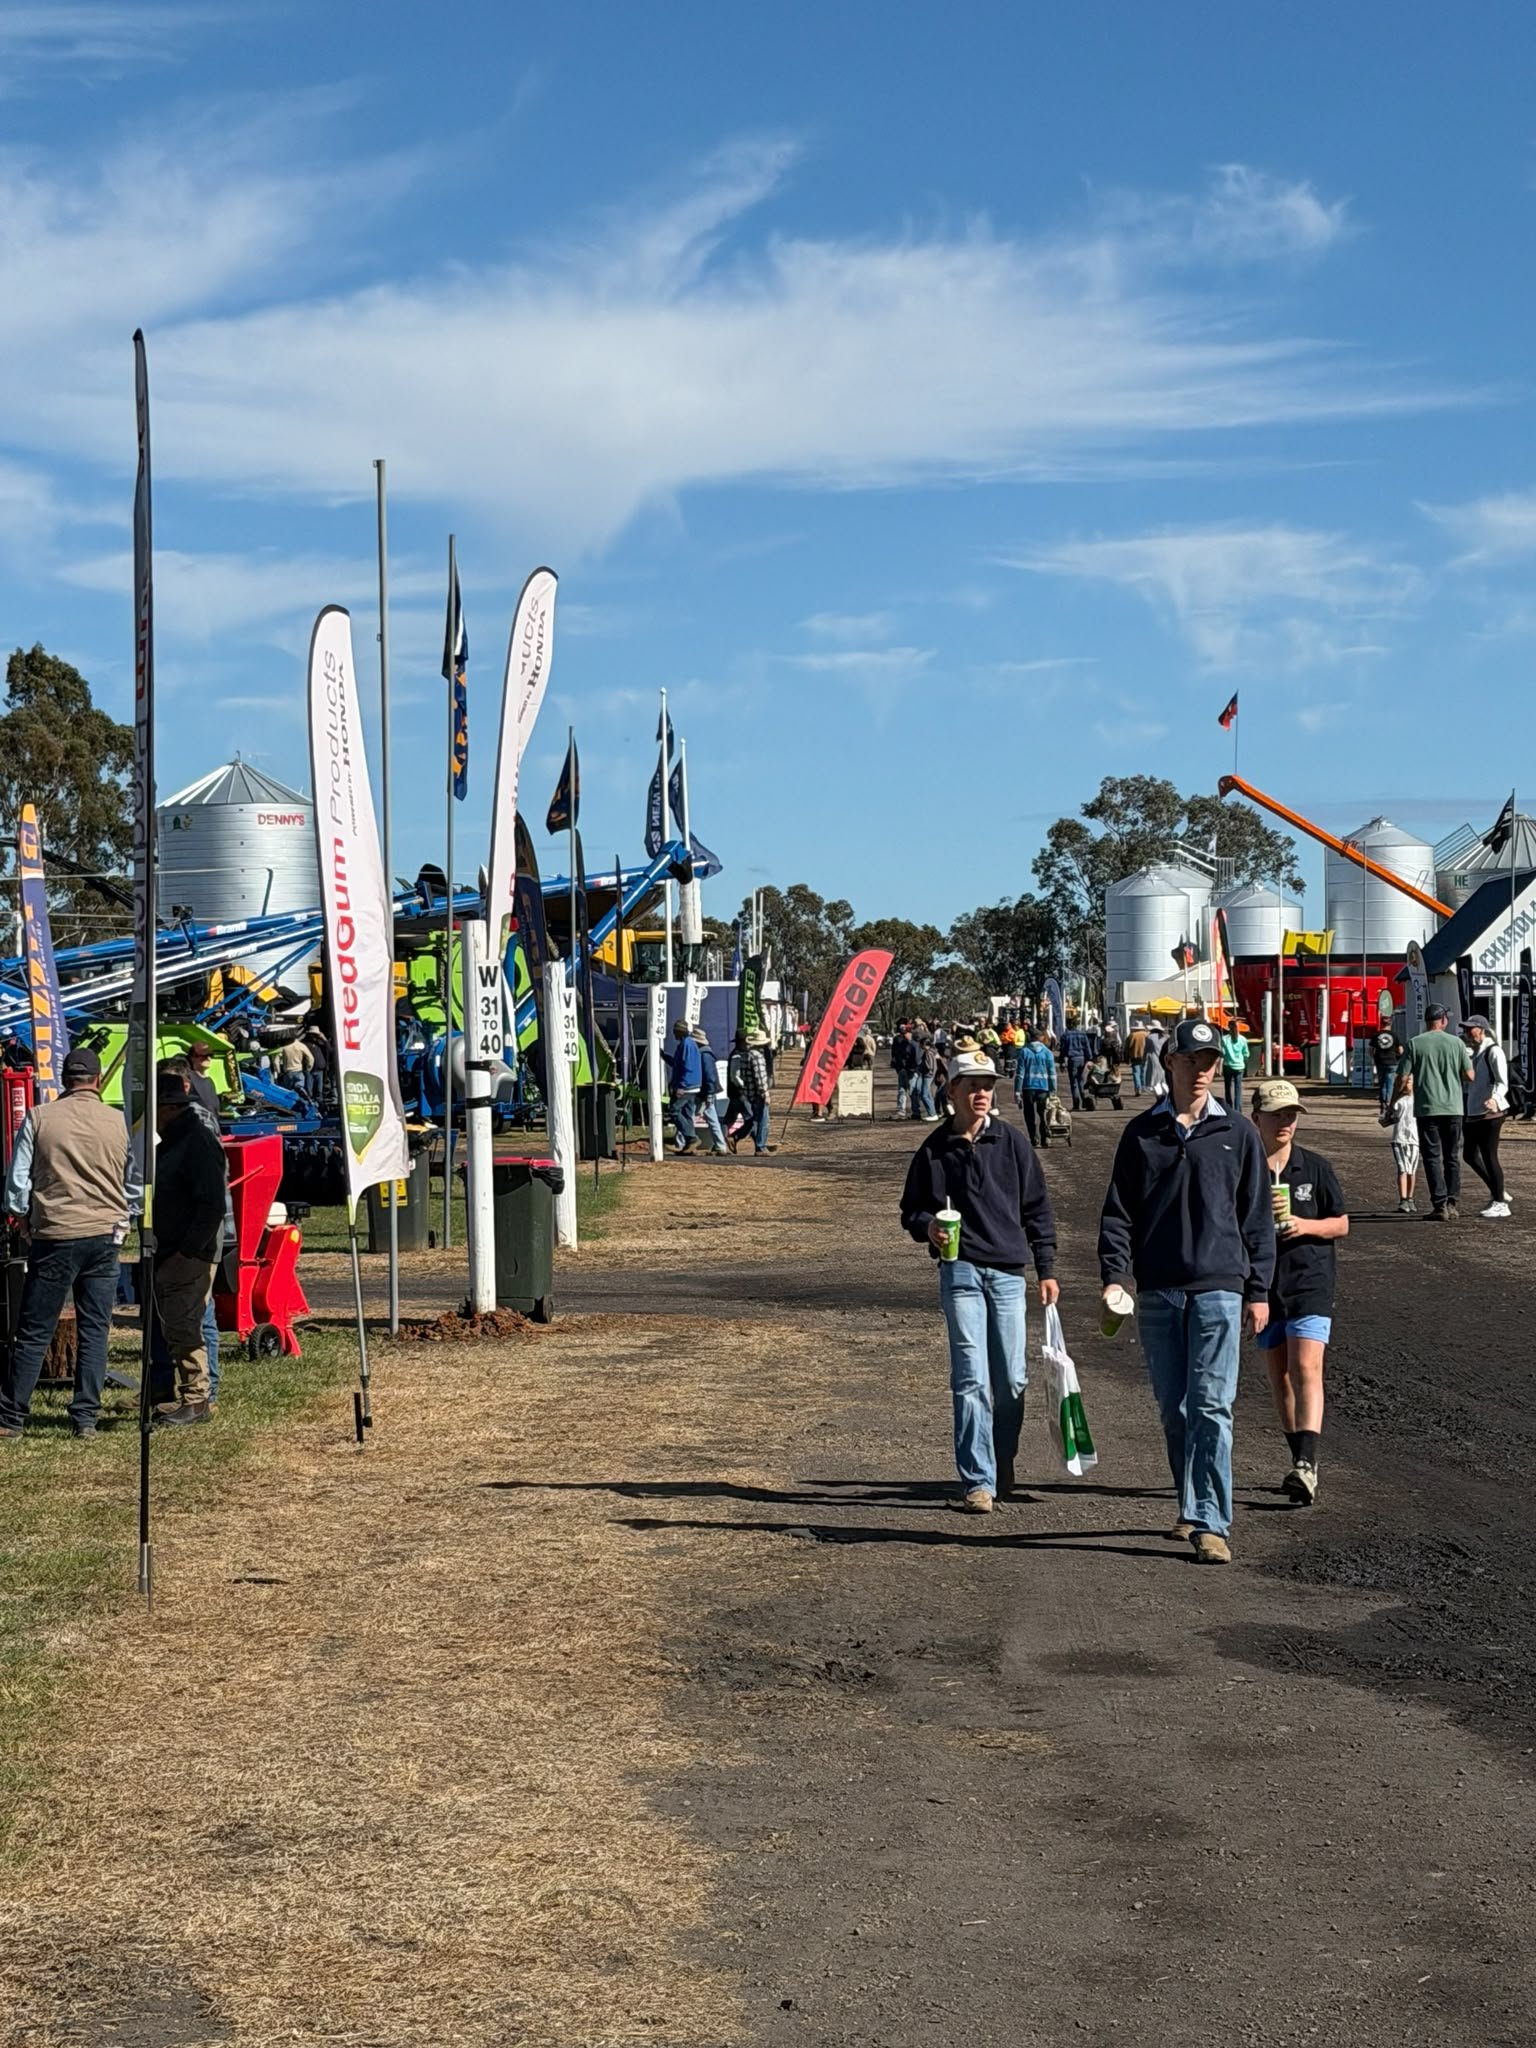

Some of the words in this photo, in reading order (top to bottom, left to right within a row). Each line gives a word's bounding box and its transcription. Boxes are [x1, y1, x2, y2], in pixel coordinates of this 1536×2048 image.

[527, 609, 546, 688] HONDA
[339, 661, 352, 769] HONDA
[325, 650, 343, 826] Products
[258, 814, 305, 826] DENNY'S
[478, 966, 498, 988] W
[481, 996, 498, 1017] 31
[563, 993, 572, 1009] V
[658, 993, 665, 1004] U
[482, 1020, 498, 1030] TO
[564, 1015, 576, 1030] 31
[810, 962, 877, 1097] COFFEE
[480, 1034, 501, 1055] 40
[564, 1042, 578, 1057] 40
